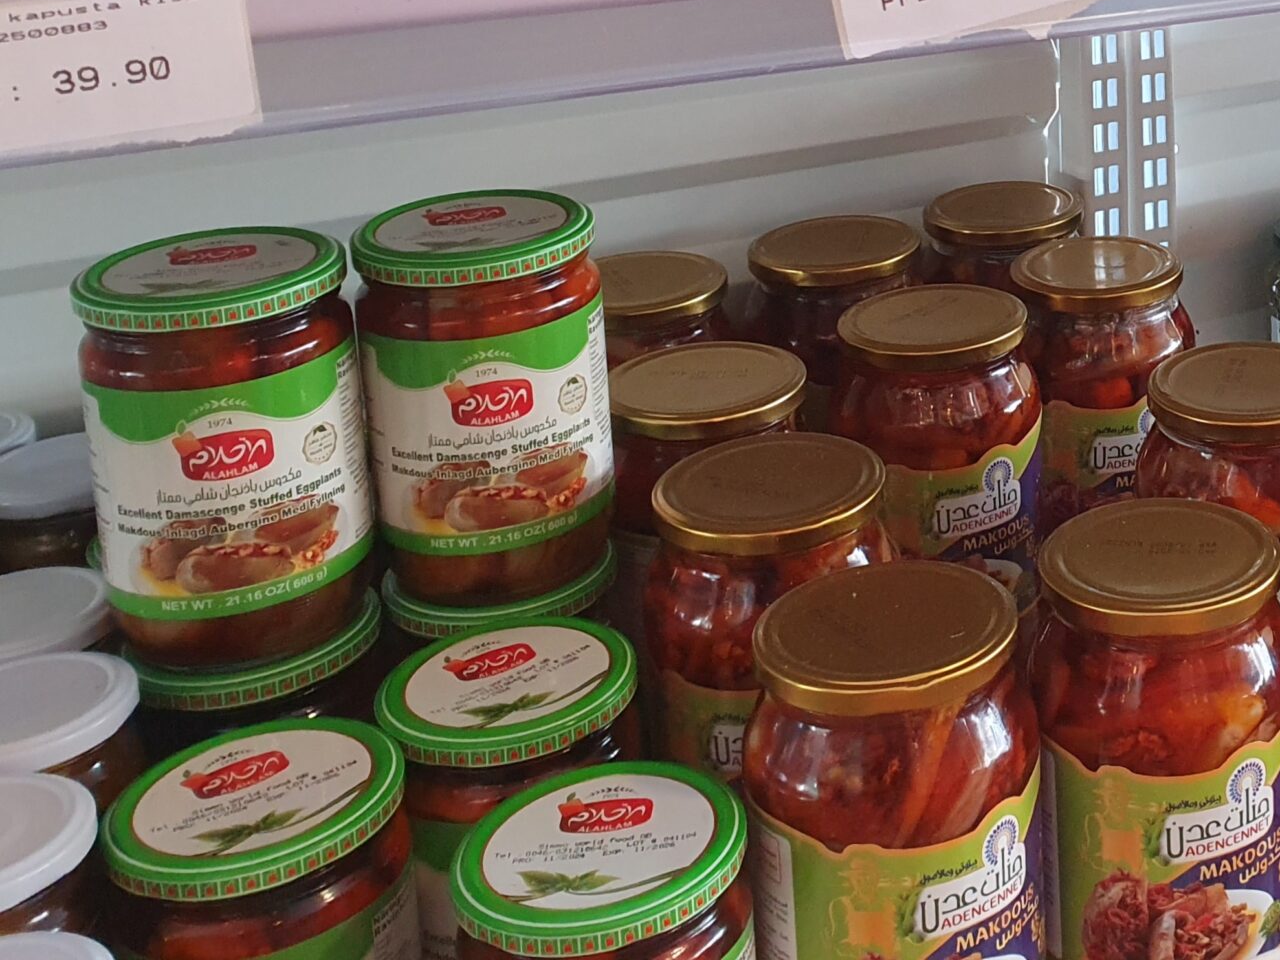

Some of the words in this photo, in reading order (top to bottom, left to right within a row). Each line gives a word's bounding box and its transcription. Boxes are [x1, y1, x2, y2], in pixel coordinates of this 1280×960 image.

[8, 1, 122, 23] kapusta
[52, 56, 171, 94] 39.90
[475, 367, 498, 378] 1974
[207, 417, 233, 429] 1974
[470, 409, 520, 426] ALAHLAM
[520, 416, 557, 439] مكدوس
[392, 463, 433, 479] Makdous
[477, 457, 536, 478] Aubergine
[538, 449, 561, 464] Med
[563, 432, 593, 457] Fyllning
[511, 436, 549, 454] Stuffed
[202, 462, 258, 480] ALAHLAM
[260, 468, 302, 493] مكدوس
[118, 505, 163, 520] Excellent
[249, 490, 293, 509] Stuffed
[296, 467, 342, 495] Eggplants
[117, 523, 161, 538] Makdous
[210, 513, 278, 535] Aubergine
[282, 504, 306, 520] Med
[310, 483, 345, 509] Fyllning
[951, 502, 1018, 533] ADENCENNET
[430, 538, 455, 550] NET
[963, 513, 1029, 551] MAKDOUS
[161, 600, 187, 612] NET
[577, 821, 633, 833] ALAHLAM
[1185, 817, 1270, 857] ADENCENNET
[941, 876, 1024, 930] ADENCENNET
[956, 883, 1034, 952] MAKDOUS
